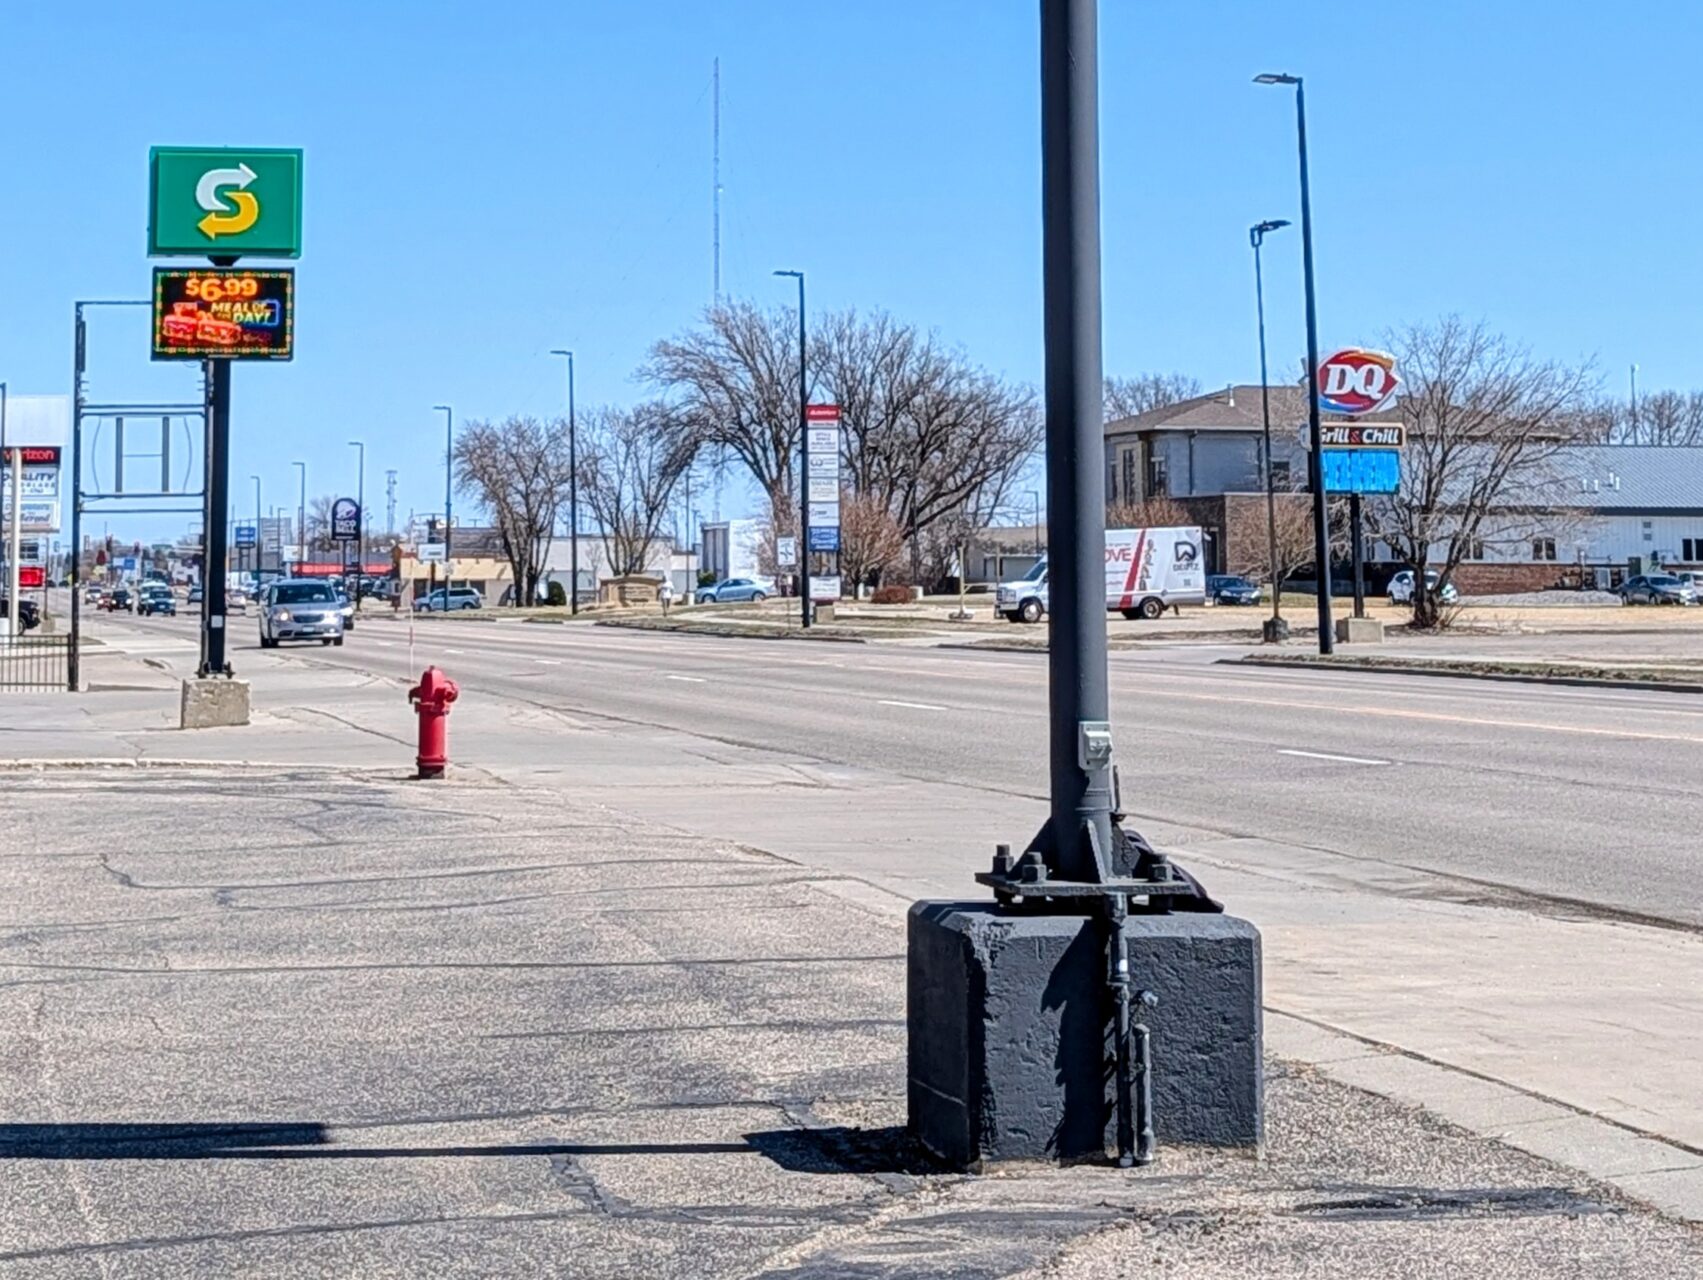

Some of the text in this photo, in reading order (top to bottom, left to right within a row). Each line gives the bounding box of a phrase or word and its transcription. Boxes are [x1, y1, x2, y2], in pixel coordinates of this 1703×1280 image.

[185, 278, 258, 302] $6.99
[1324, 363, 1386, 400] DQ
[1362, 427, 1400, 445] Chill
[3, 448, 55, 461] vrizon
